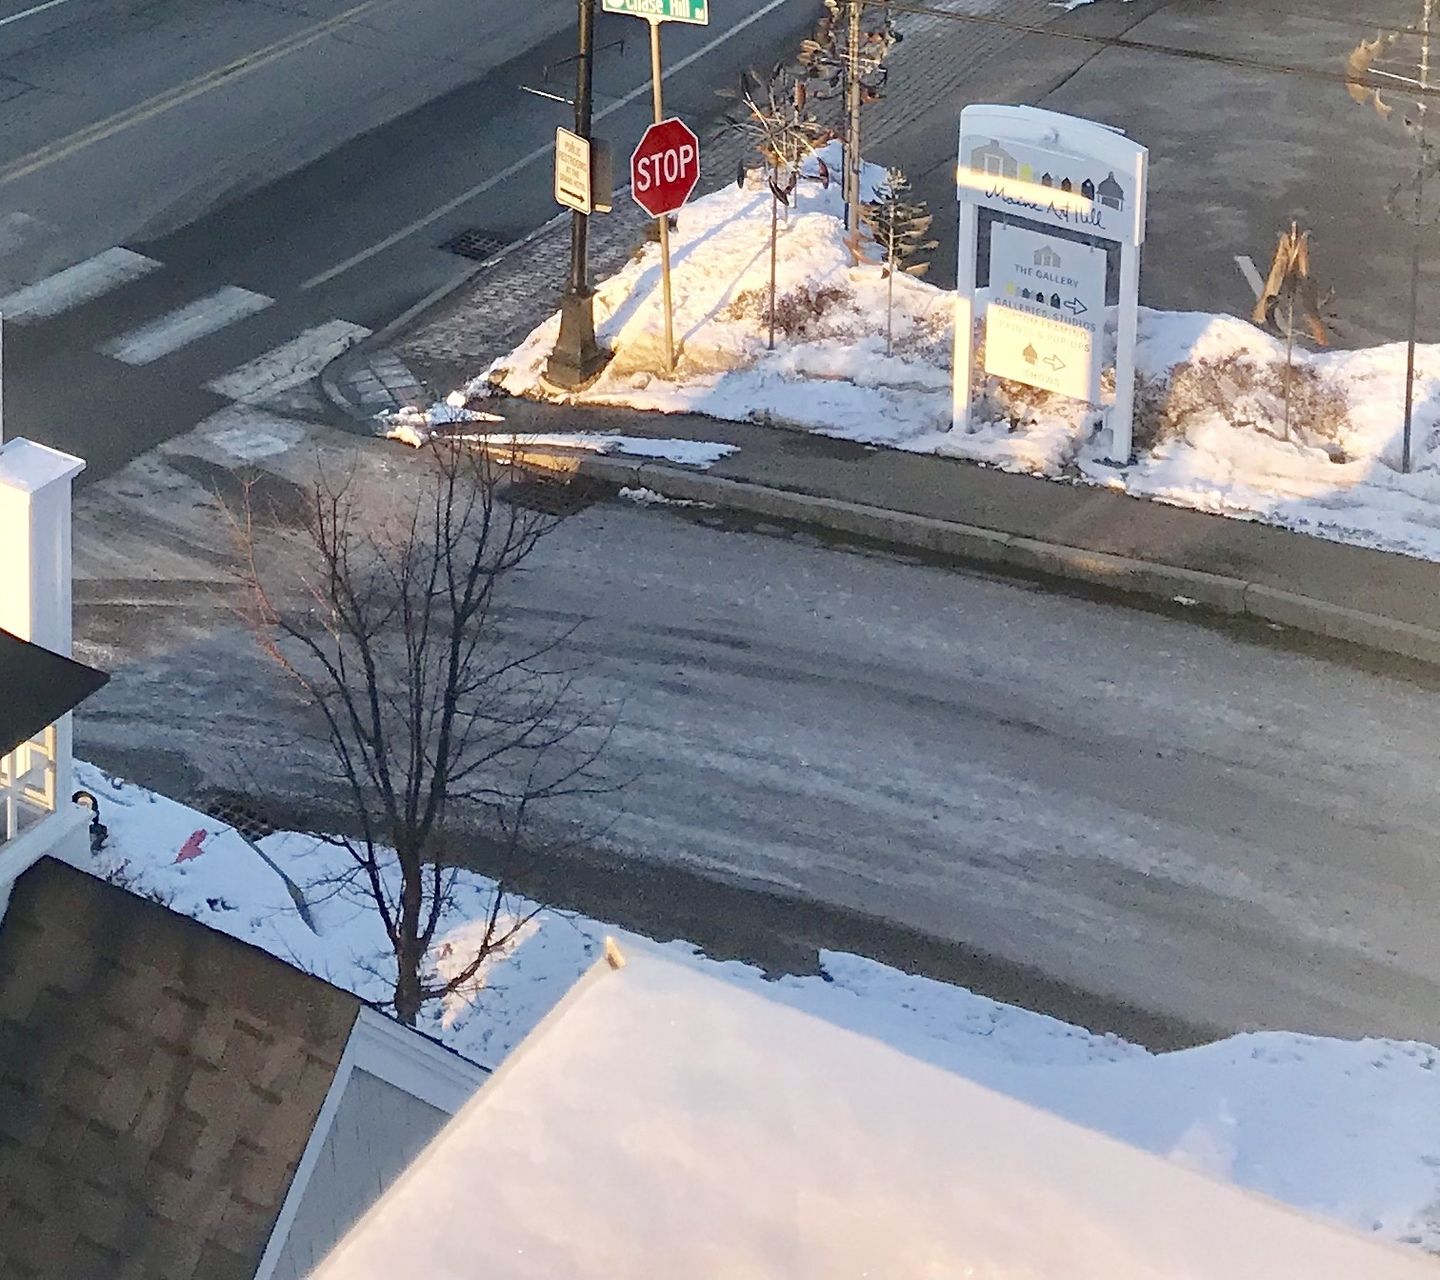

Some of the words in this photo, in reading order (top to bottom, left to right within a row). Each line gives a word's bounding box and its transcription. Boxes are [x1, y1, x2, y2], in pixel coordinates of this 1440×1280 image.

[637, 144, 694, 192] STOP
[985, 184, 1044, 212] Maine
[1046, 200, 1069, 223] Art
[1075, 205, 1106, 230] Hill
[1014, 263, 1032, 276] THE
[1035, 268, 1079, 288] GALLERY
[1052, 312, 1097, 333] STUDIOS
